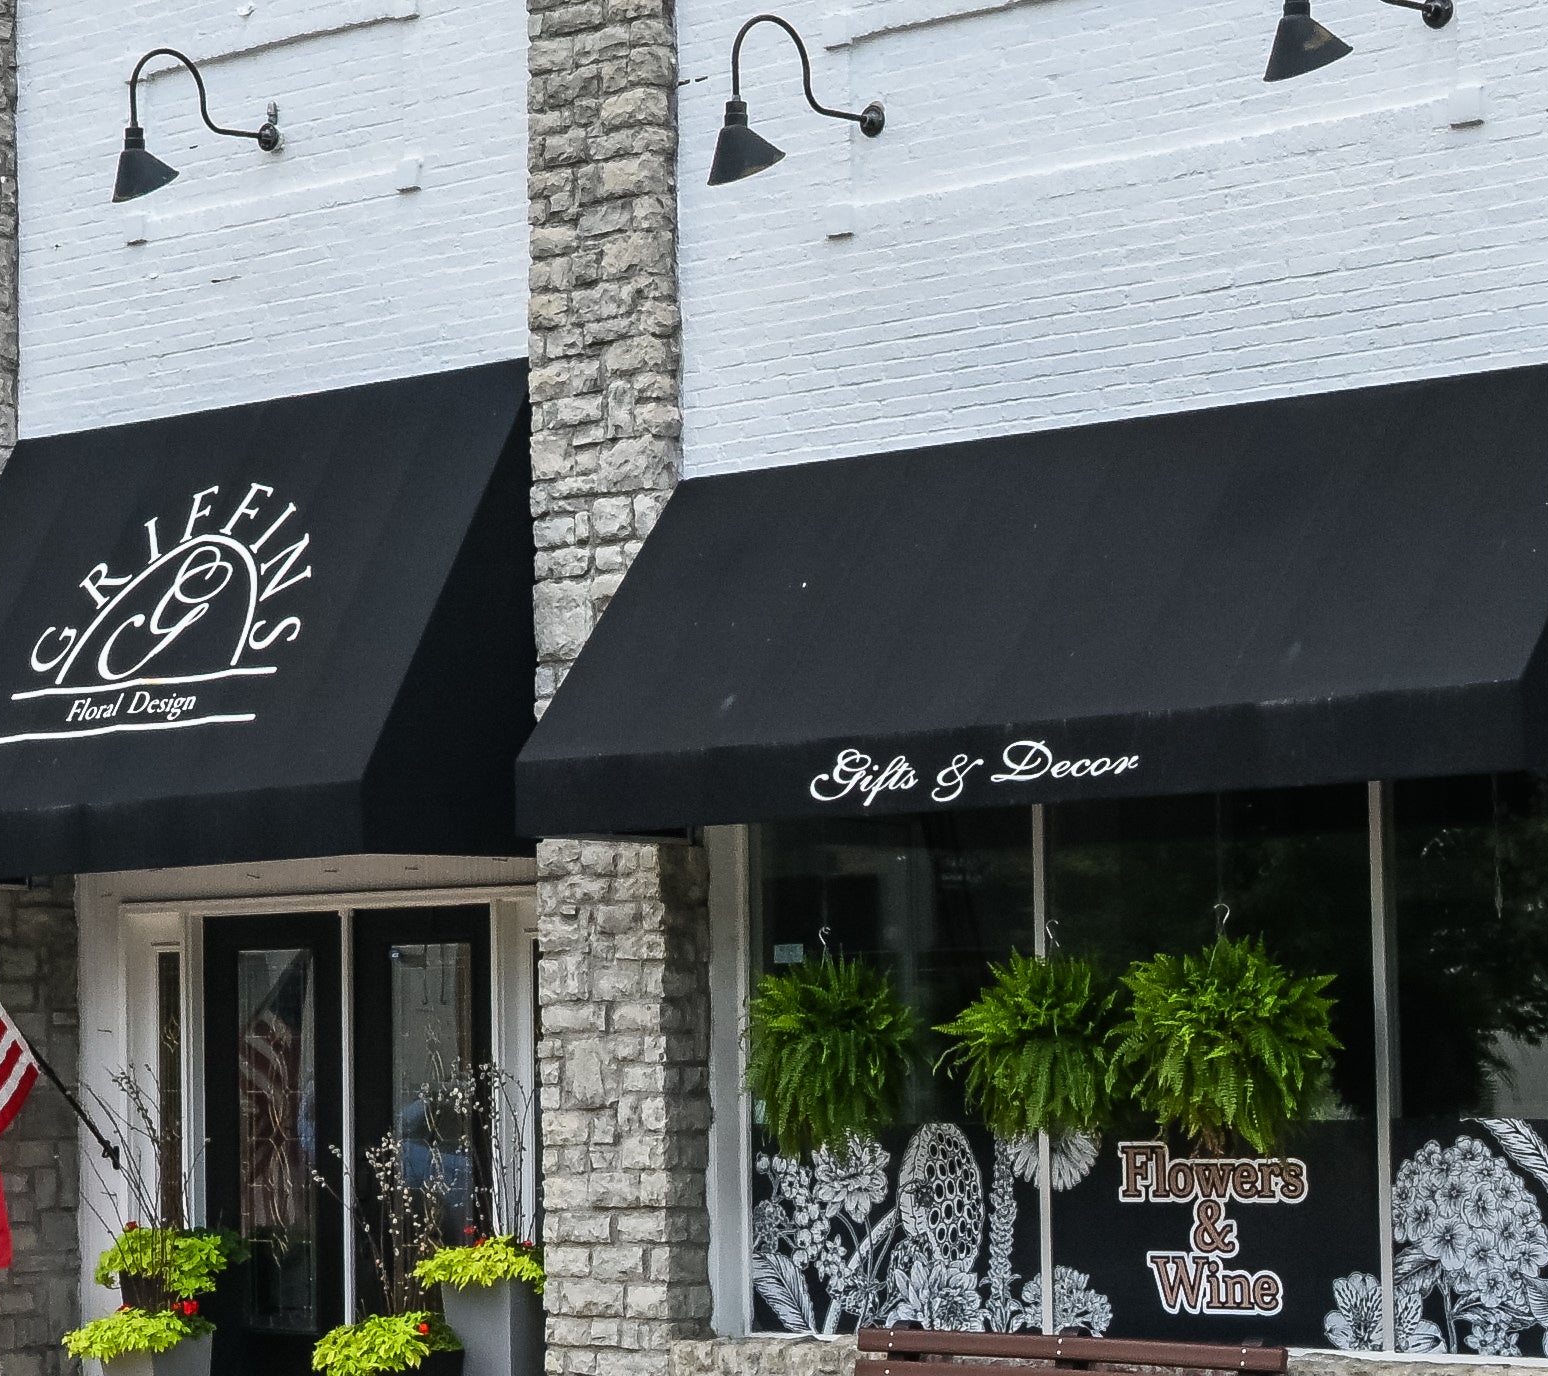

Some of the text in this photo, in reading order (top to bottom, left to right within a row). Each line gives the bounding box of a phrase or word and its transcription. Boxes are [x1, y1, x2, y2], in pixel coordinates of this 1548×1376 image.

[30, 482, 312, 673] GRIFFINS
[65, 690, 197, 723] Floral Design
[809, 739, 1139, 807] Gifts & Decor
[1118, 1141, 1308, 1204] Flowers
[1190, 1197, 1240, 1258] &
[1147, 1251, 1283, 1316] Wine
